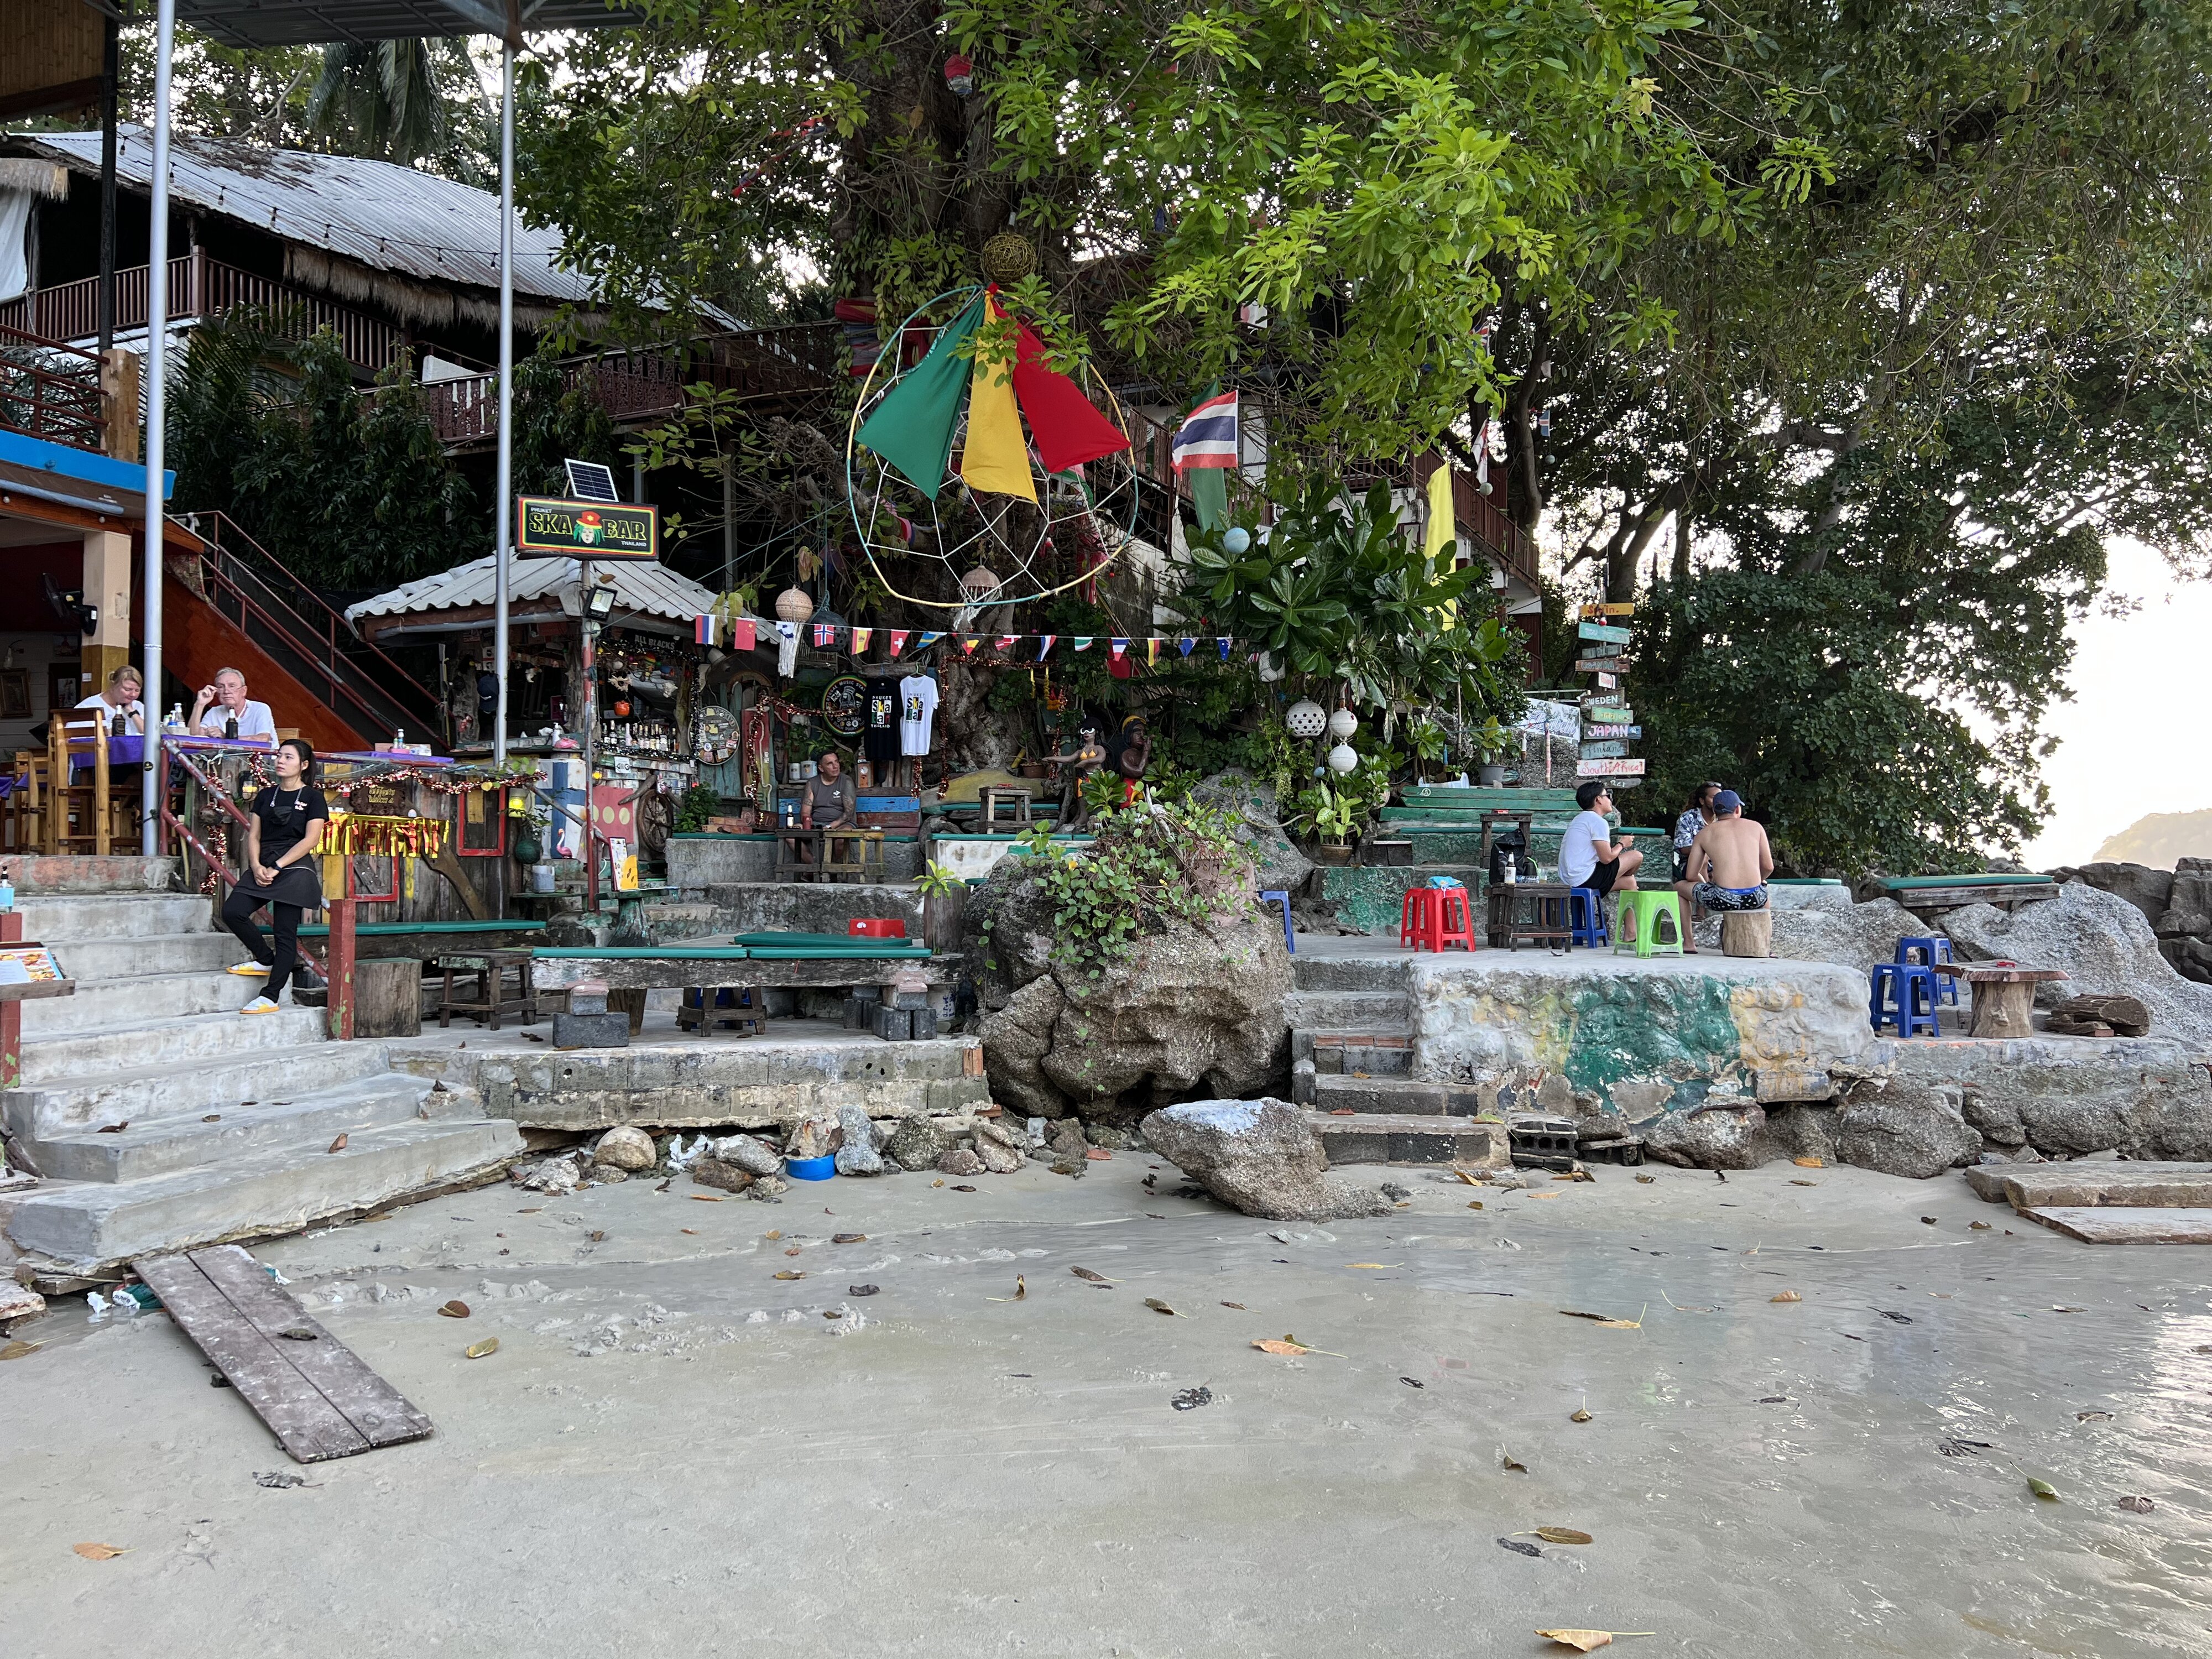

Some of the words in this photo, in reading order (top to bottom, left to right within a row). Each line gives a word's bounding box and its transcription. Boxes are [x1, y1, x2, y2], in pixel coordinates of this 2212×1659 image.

[529, 512, 573, 535] SKA
[602, 519, 647, 541] BAR
[634, 634, 647, 645] ALL
[648, 638, 675, 650] BLACKS
[872, 700, 892, 713] Ska
[907, 697, 924, 709] Ska
[1584, 695, 1618, 707] SWEDEN
[1588, 725, 1628, 737] JAPAN
